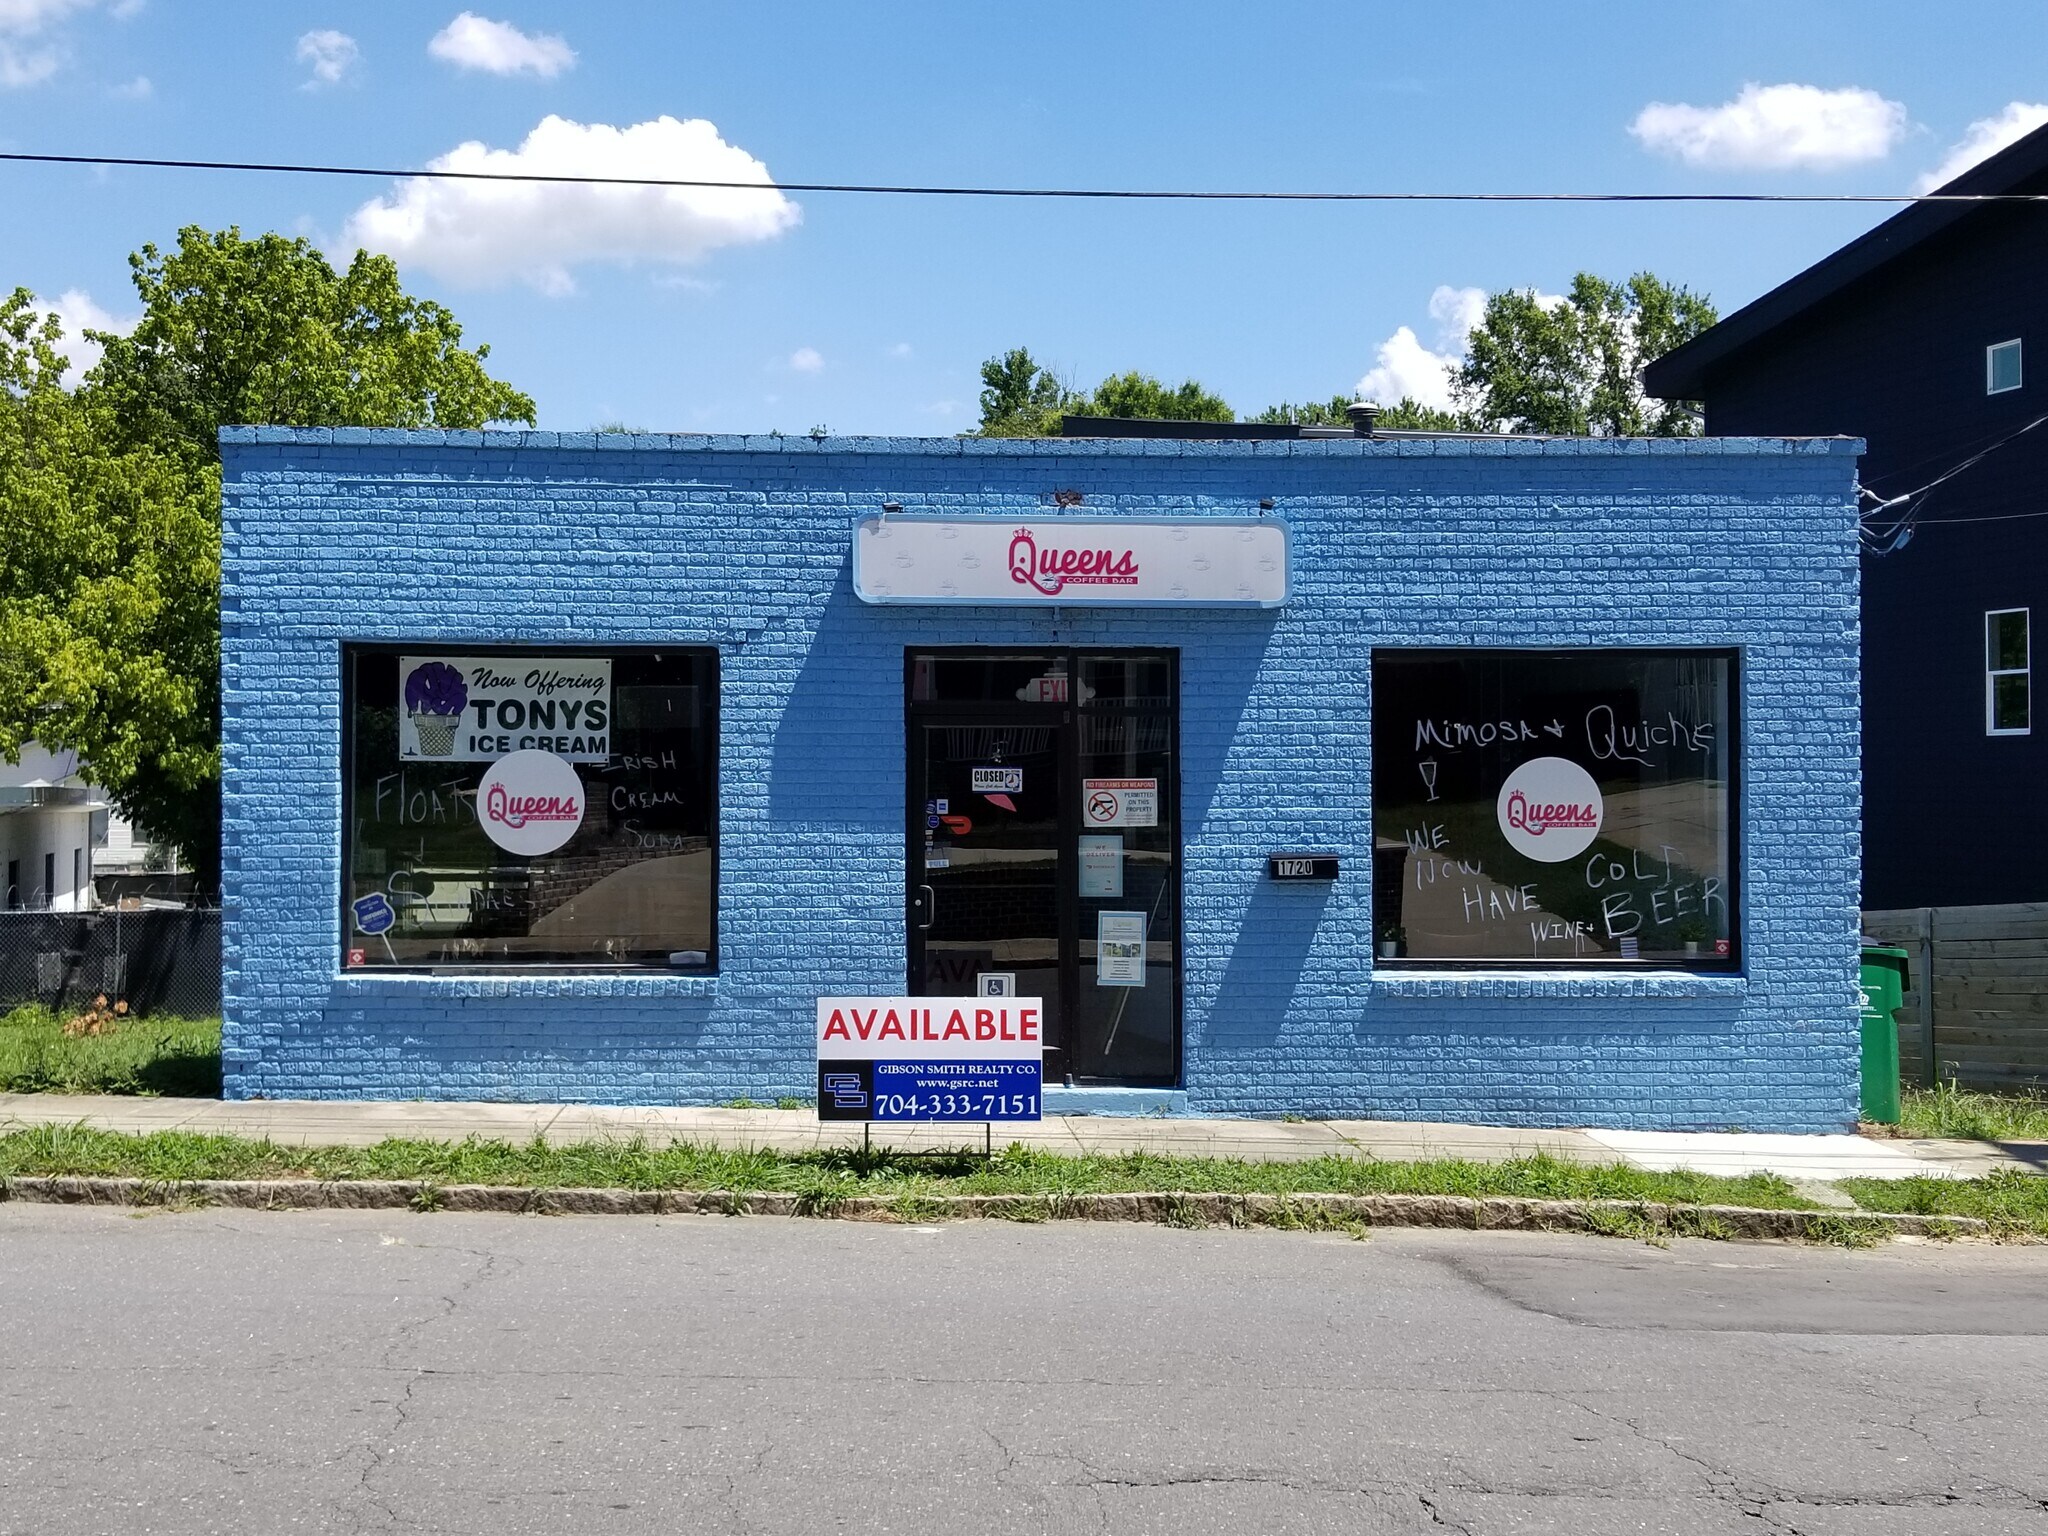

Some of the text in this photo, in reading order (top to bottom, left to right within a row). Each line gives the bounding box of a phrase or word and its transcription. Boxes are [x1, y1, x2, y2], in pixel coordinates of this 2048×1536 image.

[1008, 533, 1139, 596] Queens
[471, 667, 607, 697] Now Offering
[1040, 679, 1068, 702] EXI
[469, 698, 608, 731] TONYS
[469, 735, 606, 754] ICE CREAM
[974, 770, 1004, 782] CLOSED
[487, 787, 579, 830] Queens
[1507, 795, 1597, 835] Queens
[1405, 820, 1450, 855] WE
[1280, 860, 1312, 875] 1720
[1416, 858, 1482, 891] NOW
[1459, 883, 1541, 923] HAVE
[1601, 877, 1727, 940] BEER
[822, 1008, 1038, 1041] AVAILABLE
[878, 1065, 1037, 1074] GIBSON SMITH REALTY CO.
[916, 1078, 999, 1089] www.gsrc.net
[875, 1094, 1038, 1116] 704-333-7151
